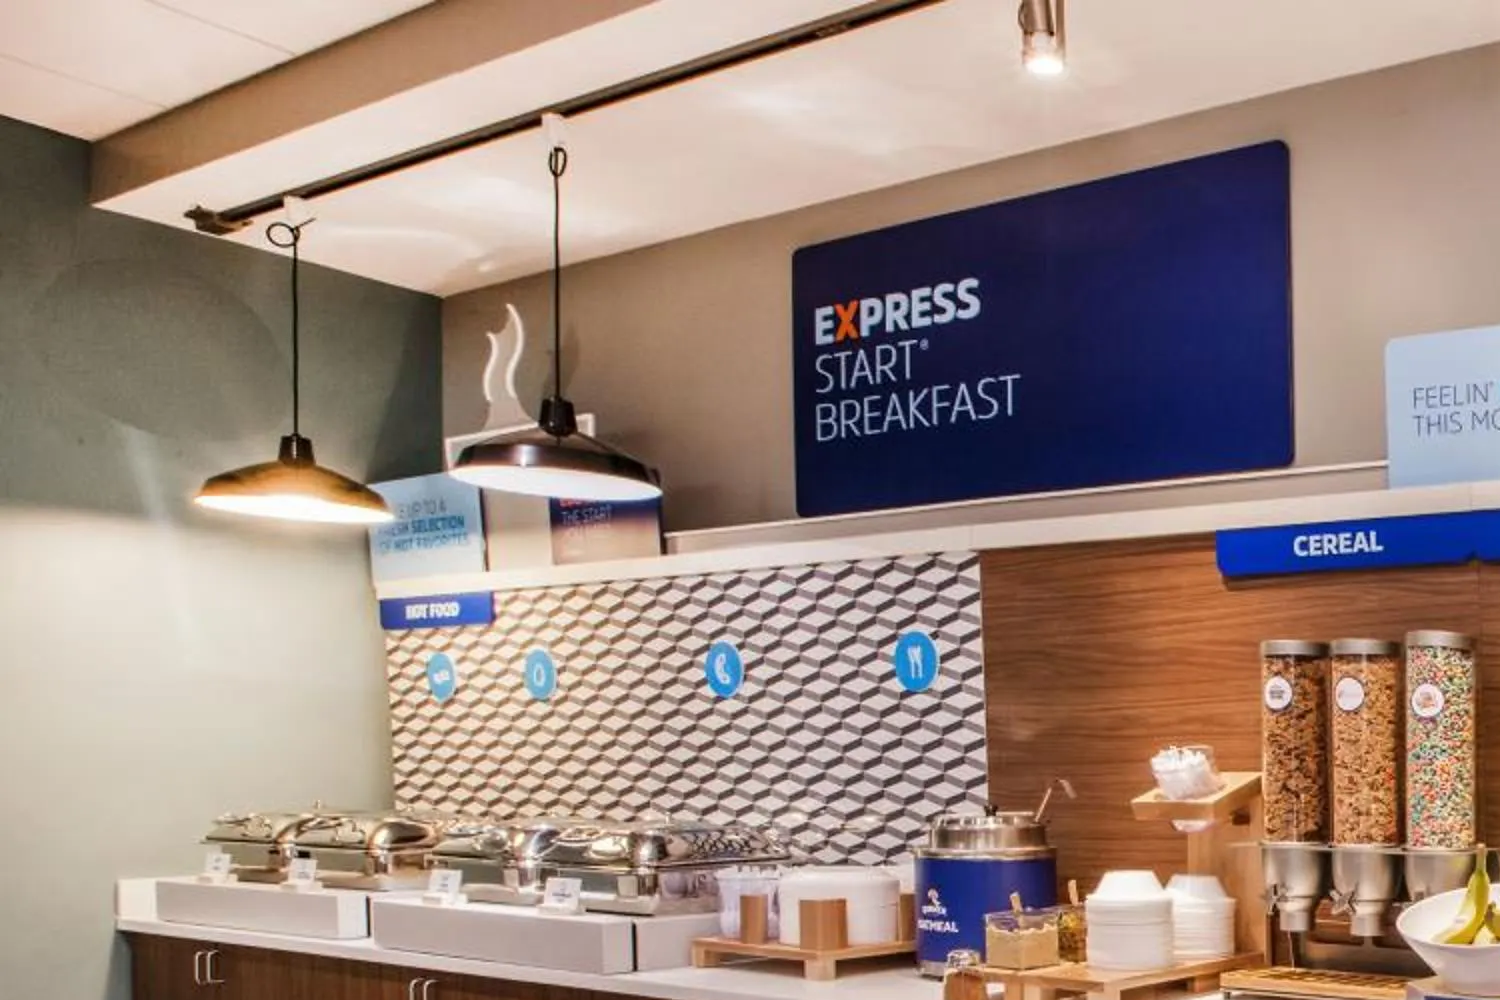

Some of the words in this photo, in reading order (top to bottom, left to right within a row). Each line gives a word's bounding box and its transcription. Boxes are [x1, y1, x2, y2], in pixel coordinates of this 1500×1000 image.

[814, 277, 981, 346] EXPRESS
[815, 373, 1022, 442] BREAKFAST
[1413, 410, 1463, 438] THIS
[412, 514, 466, 534] SELECTION
[1293, 530, 1384, 558] CEREAL
[404, 603, 428, 621] HOT
[429, 601, 460, 619] FOOD
